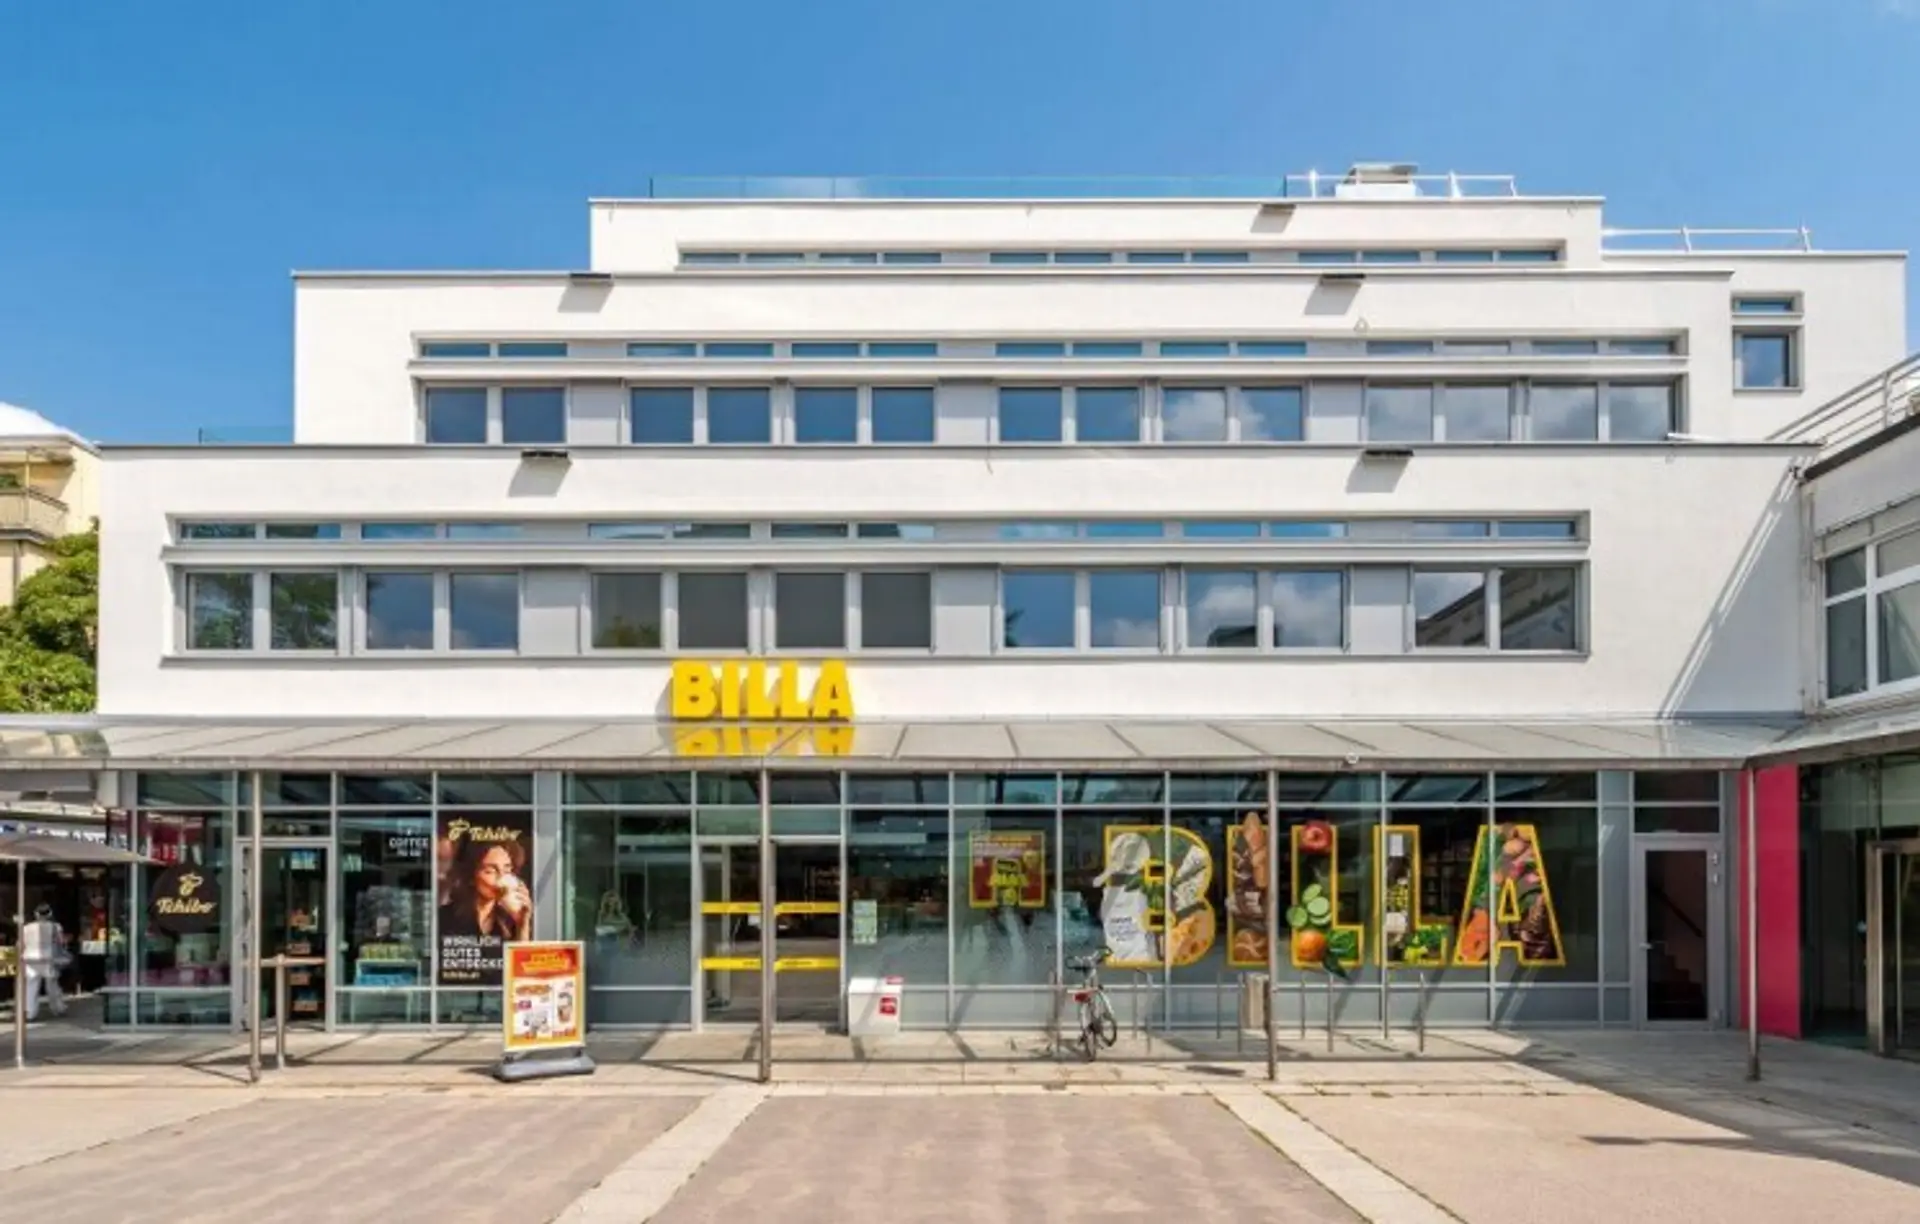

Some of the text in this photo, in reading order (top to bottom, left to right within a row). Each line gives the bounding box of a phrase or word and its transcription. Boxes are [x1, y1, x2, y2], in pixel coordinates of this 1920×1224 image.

[671, 659, 854, 719] BILLA
[469, 827, 522, 841] Tchibo
[156, 897, 216, 914] Tchibo
[1105, 824, 1565, 967] BILLA
